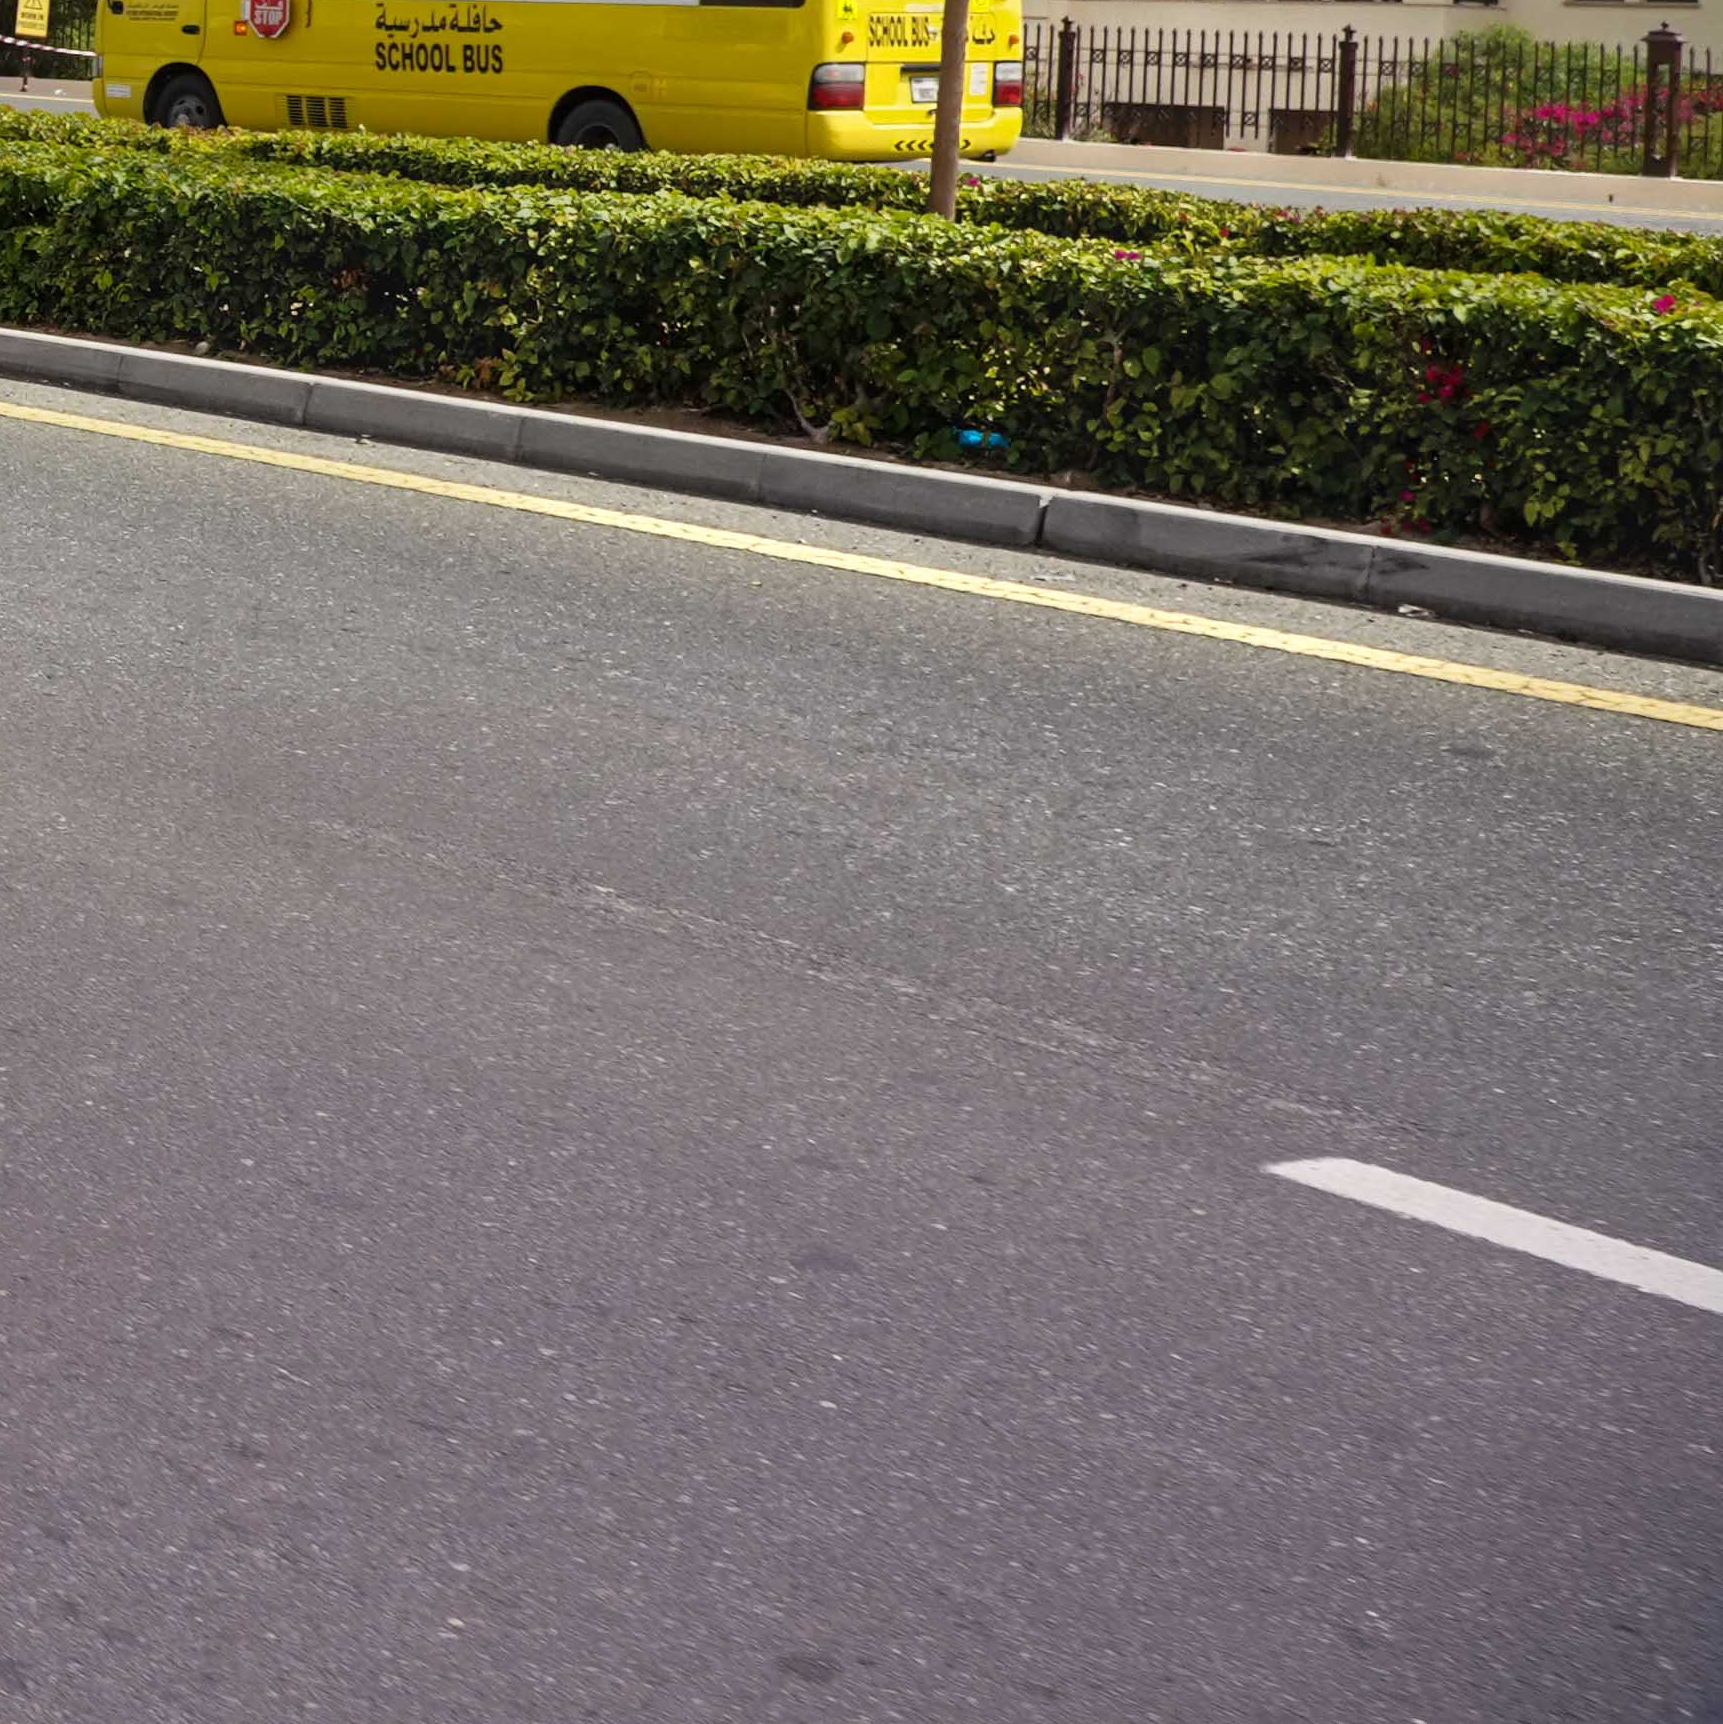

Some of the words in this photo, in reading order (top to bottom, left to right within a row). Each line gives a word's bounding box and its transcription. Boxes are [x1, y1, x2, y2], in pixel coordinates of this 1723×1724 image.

[254, 10, 283, 25] STOP
[375, 3, 447, 39] مدرسية
[449, 3, 504, 33] حافلة
[869, 15, 908, 48] SCHOOL
[911, 15, 931, 48] BUS
[375, 42, 456, 72] SCHOOL
[462, 44, 504, 74] BUS
